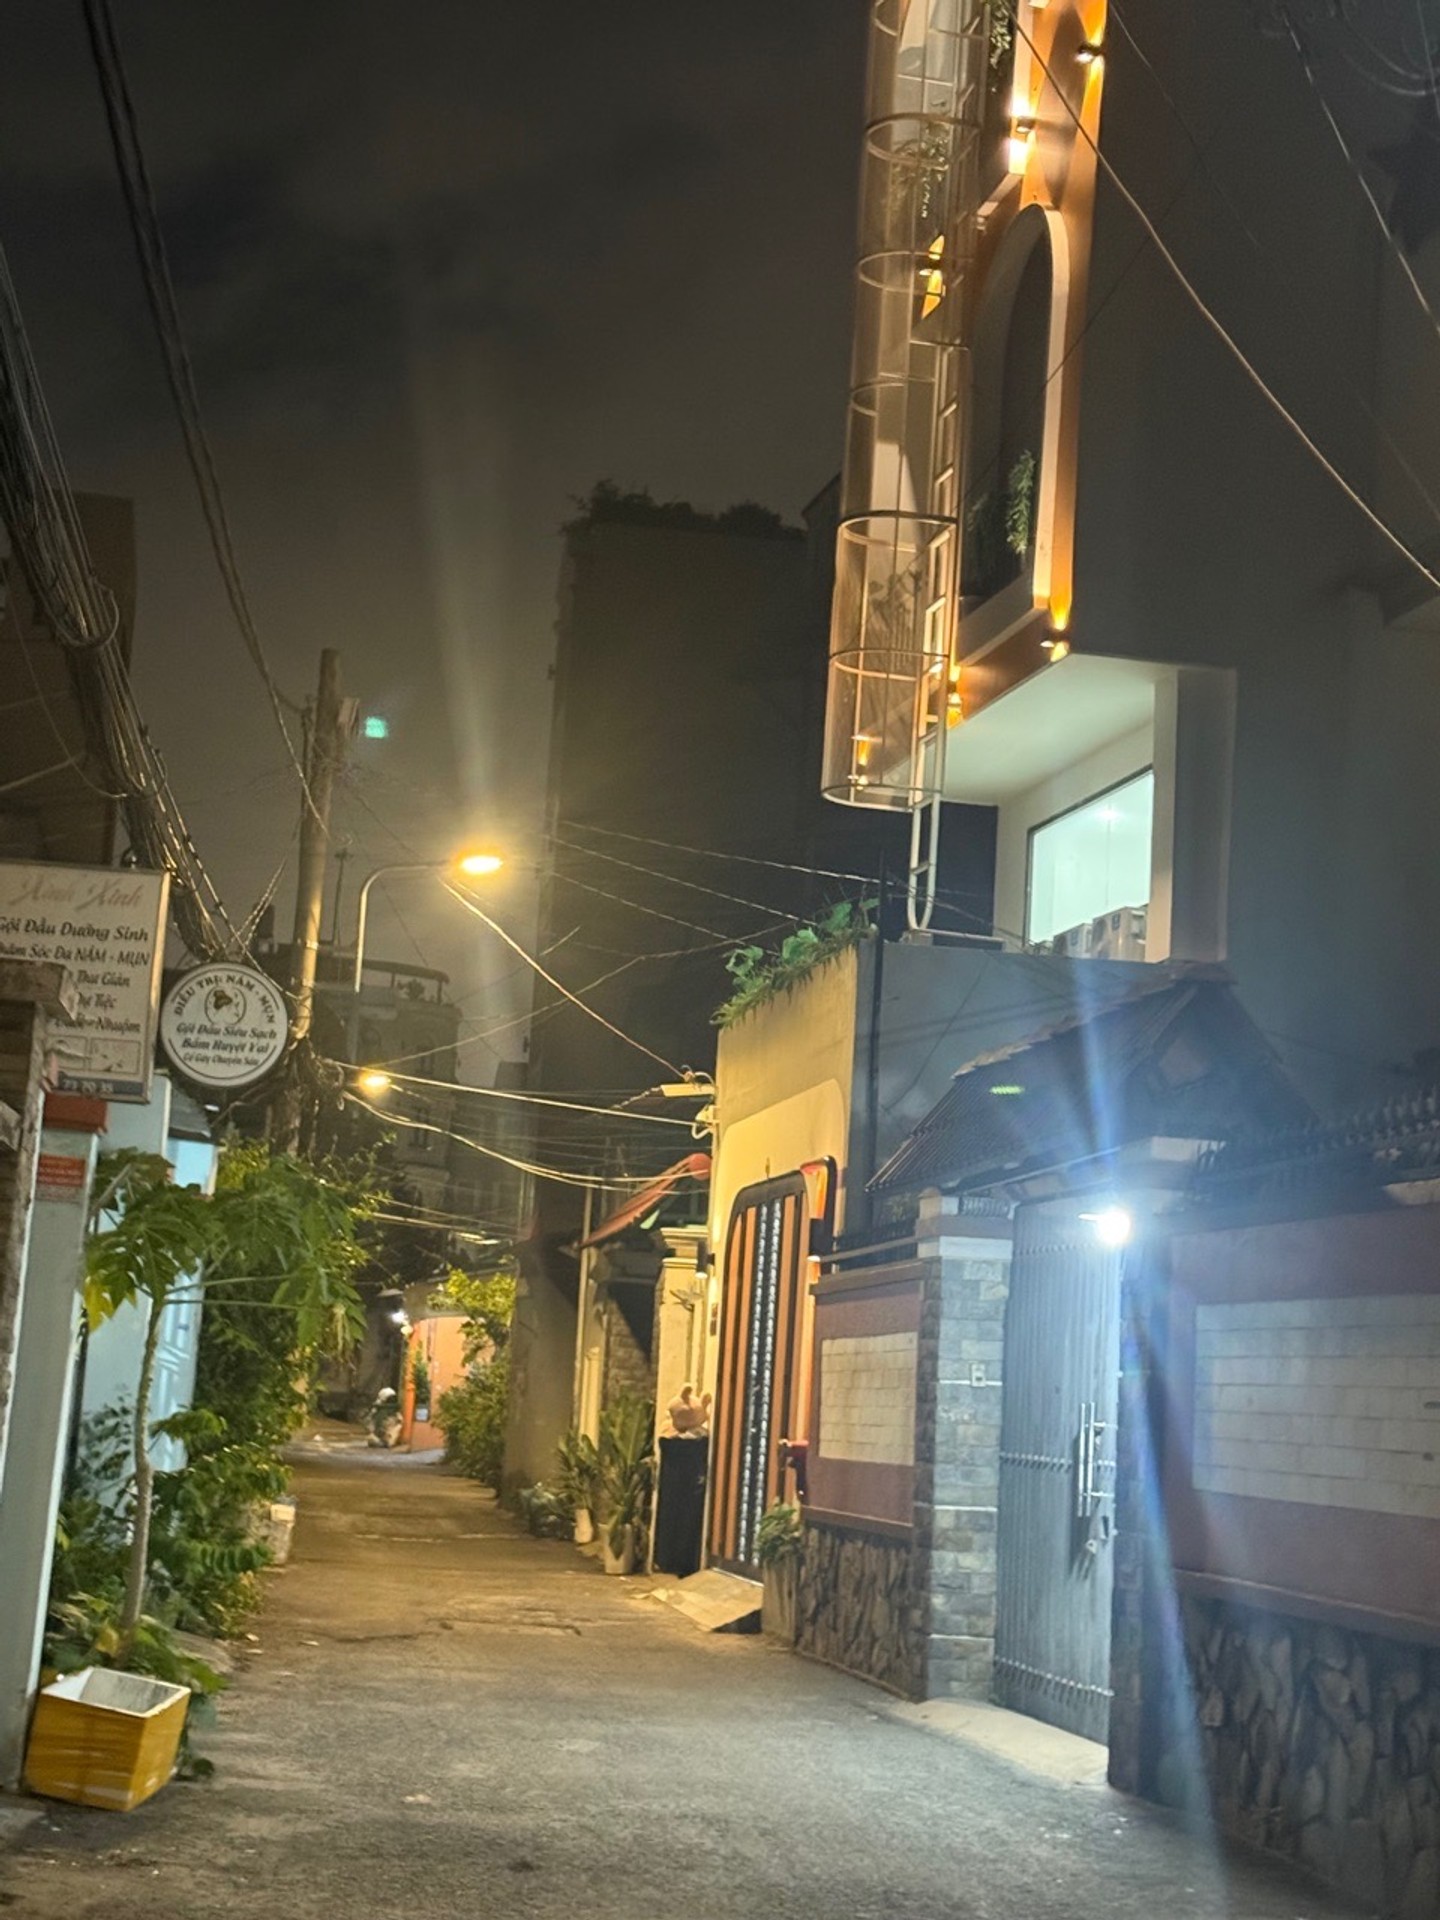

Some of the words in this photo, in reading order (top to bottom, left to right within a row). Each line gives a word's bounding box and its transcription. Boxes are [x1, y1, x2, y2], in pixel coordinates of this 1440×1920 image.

[113, 926, 148, 941] Sinh
[54, 945, 72, 960] Da
[117, 950, 151, 967] MỤN
[226, 974, 256, 993] NÁM
